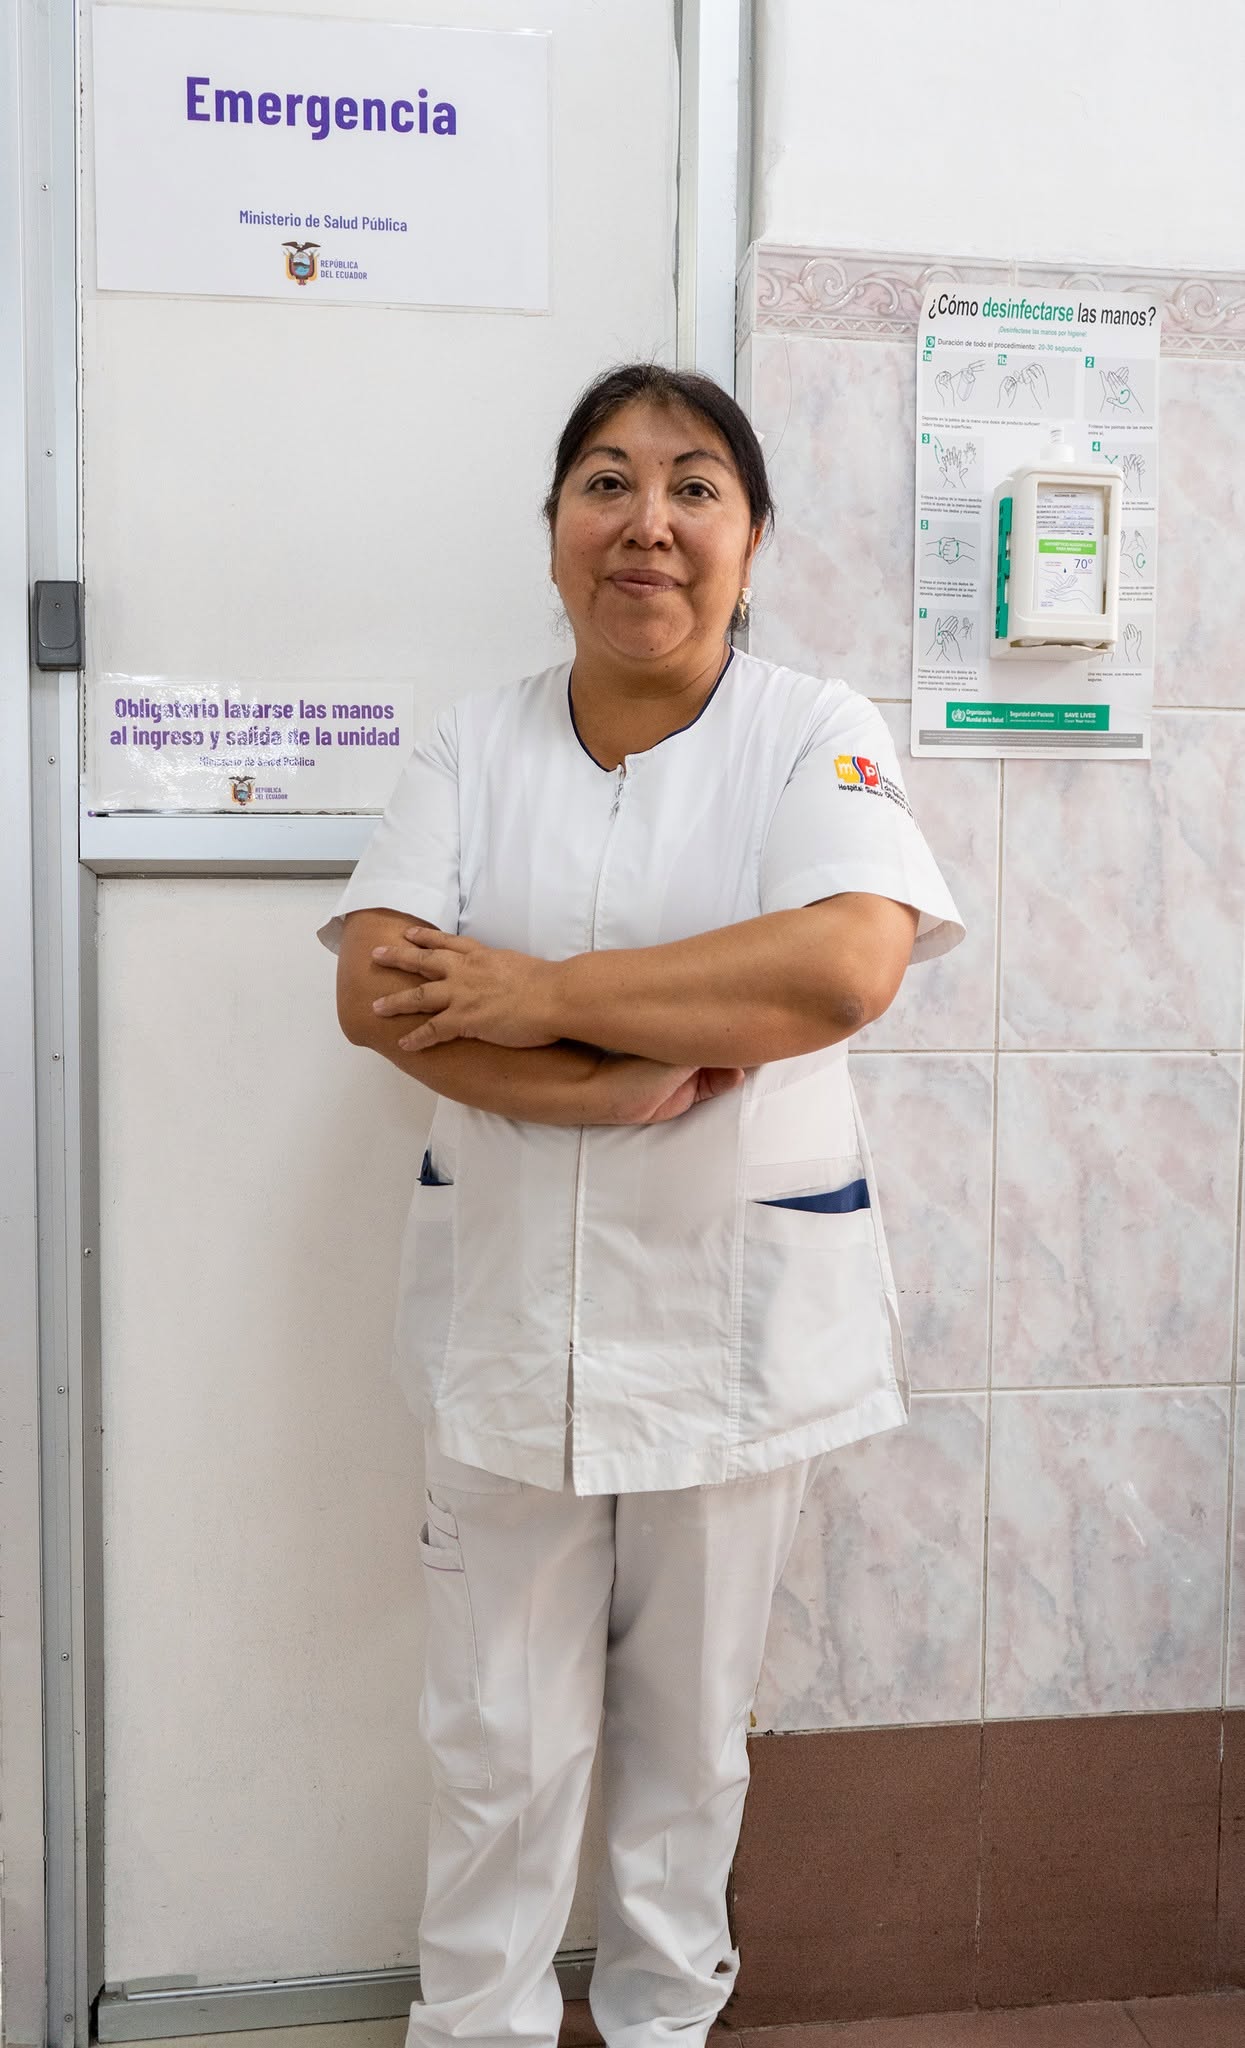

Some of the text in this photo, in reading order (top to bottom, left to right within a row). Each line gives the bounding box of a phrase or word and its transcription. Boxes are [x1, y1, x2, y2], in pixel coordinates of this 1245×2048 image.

[187, 76, 457, 140] Emergencia
[239, 210, 408, 232] Ministerio de Salud Pública
[320, 258, 358, 269] REPÚBLICA
[320, 270, 368, 281] DEL ECUADOR
[928, 294, 1157, 327] ¿Cómo desinfectarse las manos?
[937, 339, 963, 347] Duración
[964, 340, 973, 348] de
[974, 341, 987, 349] todo
[1054, 345, 1083, 353] segundos
[1086, 358, 1093, 368] 2
[224, 699, 294, 720] lavarse
[299, 699, 327, 720] las
[332, 704, 395, 720] manos
[109, 725, 127, 745] al
[132, 726, 205, 750] ingreso
[209, 731, 220, 750] y
[226, 726, 282, 746] salida
[315, 726, 332, 746] la
[337, 726, 400, 746] unidad
